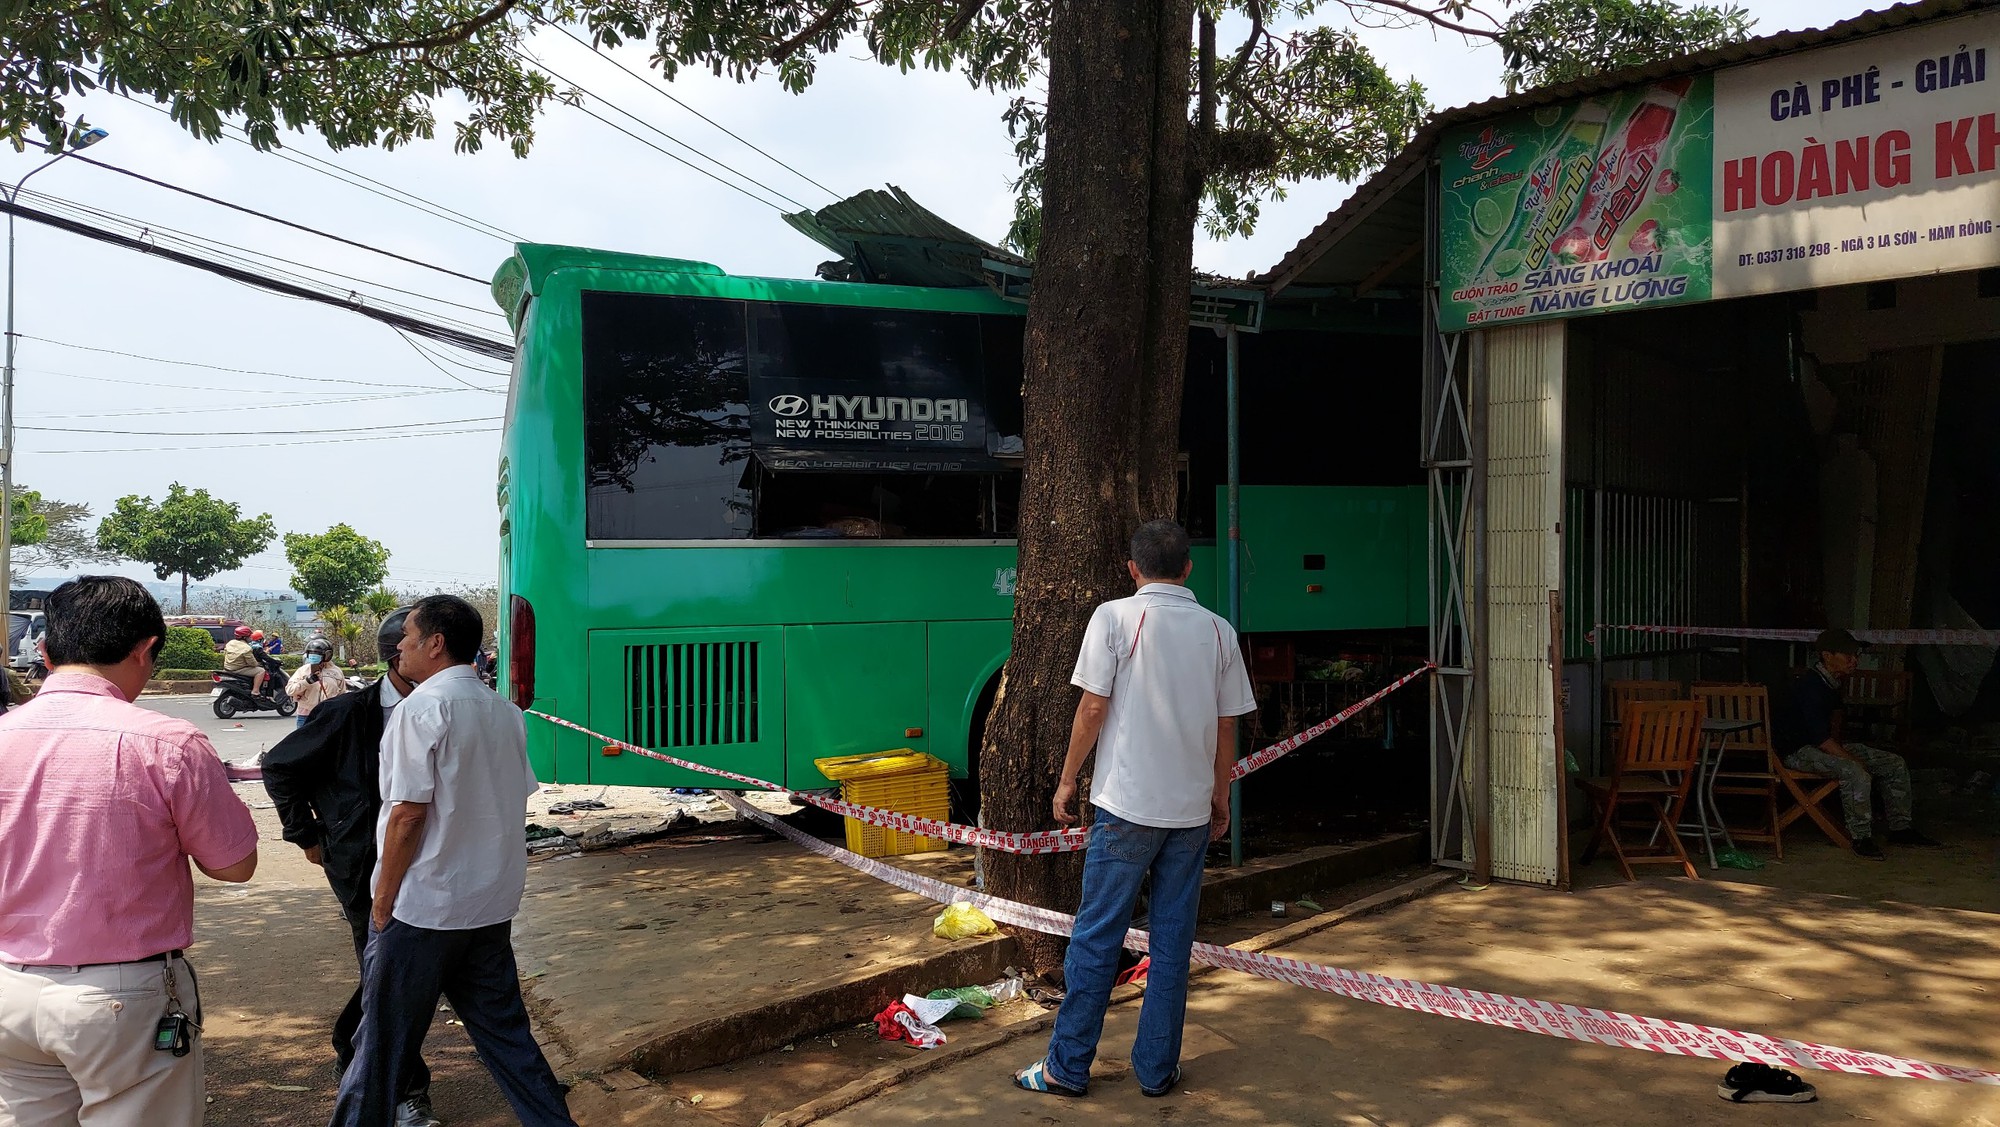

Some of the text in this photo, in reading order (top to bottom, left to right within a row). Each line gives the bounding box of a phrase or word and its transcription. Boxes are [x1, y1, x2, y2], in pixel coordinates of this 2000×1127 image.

[1770, 81, 1811, 122] CÀ
[1822, 65, 1880, 112] PHÊ
[1914, 44, 1986, 93] GIẢI
[1452, 167, 1500, 189] chanh
[1723, 129, 1911, 212] HOÀNG
[1526, 154, 1594, 270] chanh
[1739, 254, 1754, 266] ĐT:
[1757, 249, 1783, 264] 0337
[1786, 246, 1806, 261] 318
[1809, 242, 1830, 257] 298
[1841, 236, 1864, 252] NGÃ
[1867, 236, 1874, 249] 3
[1878, 234, 1890, 248] LA
[1894, 230, 1917, 246] SƠN
[1591, 251, 1663, 281] KHOÁI
[1468, 276, 1688, 323] BẬT TUNG NĂNG LƯỢNG
[775, 419, 880, 430] NEW THINKING
[811, 394, 969, 422] HYUNDAI
[775, 424, 964, 442] NEW POSSIBILITIES 2016
